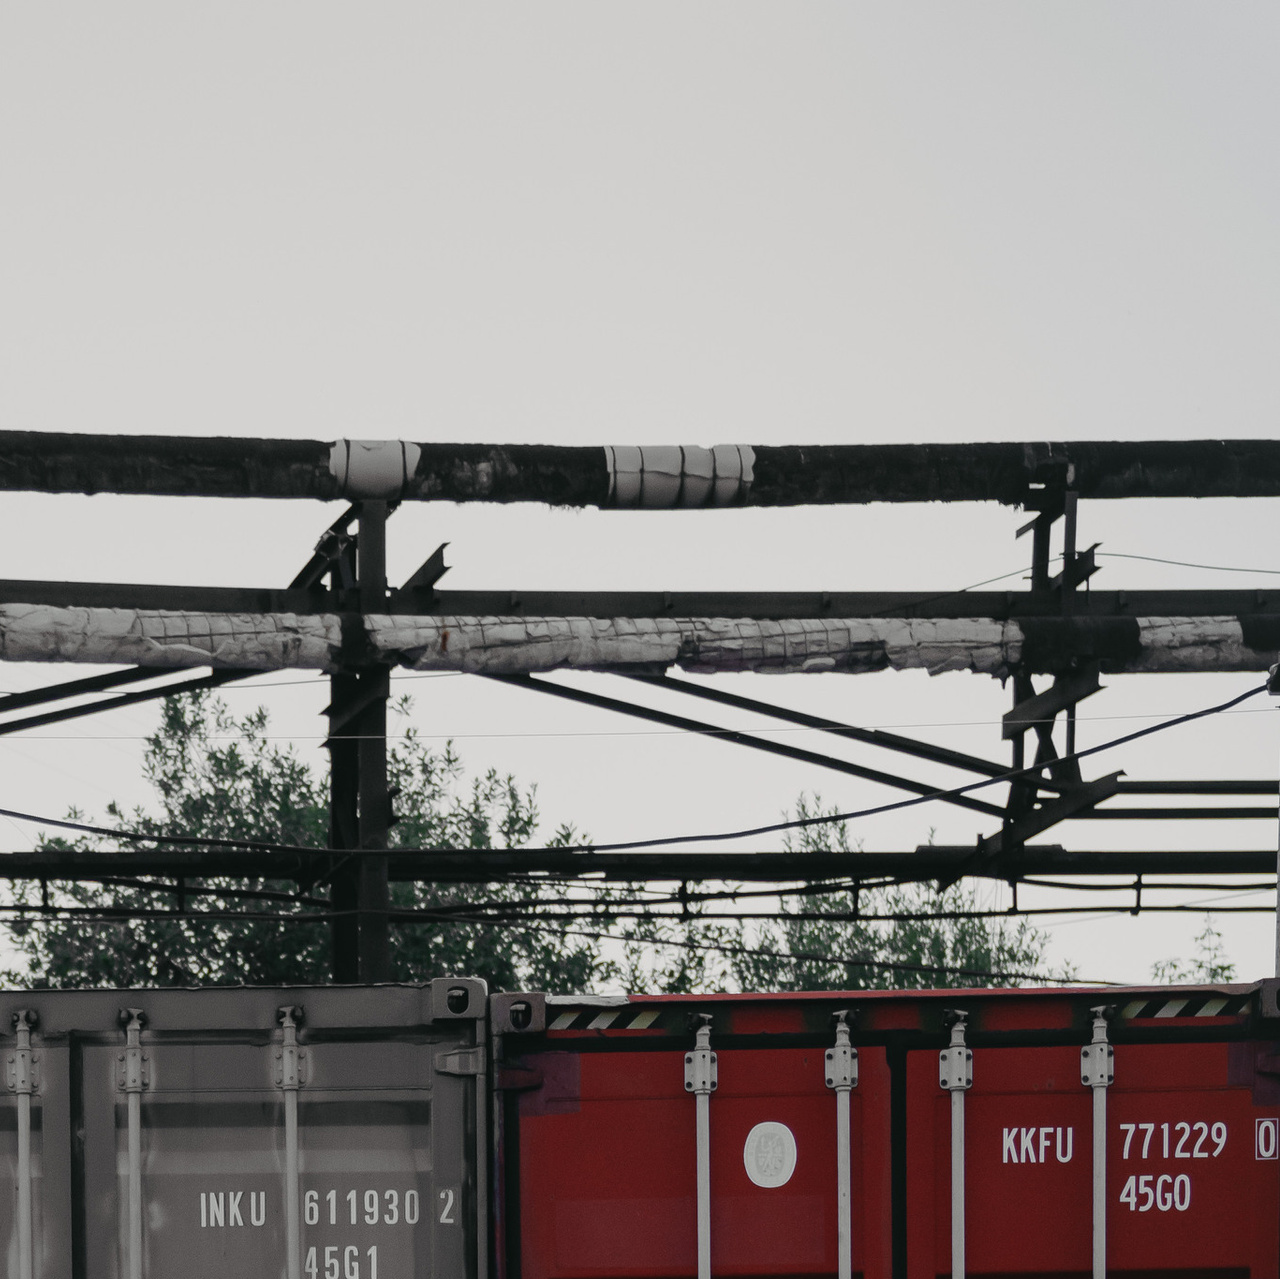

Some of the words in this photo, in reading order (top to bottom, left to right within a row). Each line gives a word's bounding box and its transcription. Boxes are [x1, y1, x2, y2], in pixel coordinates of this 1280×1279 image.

[1002, 1126, 1073, 1164] KKFU
[1119, 1121, 1228, 1160] 771229
[1258, 1120, 1276, 1158] 0
[200, 1191, 266, 1228] INKU
[304, 1189, 420, 1225] 611930
[439, 1188, 455, 1224] 2
